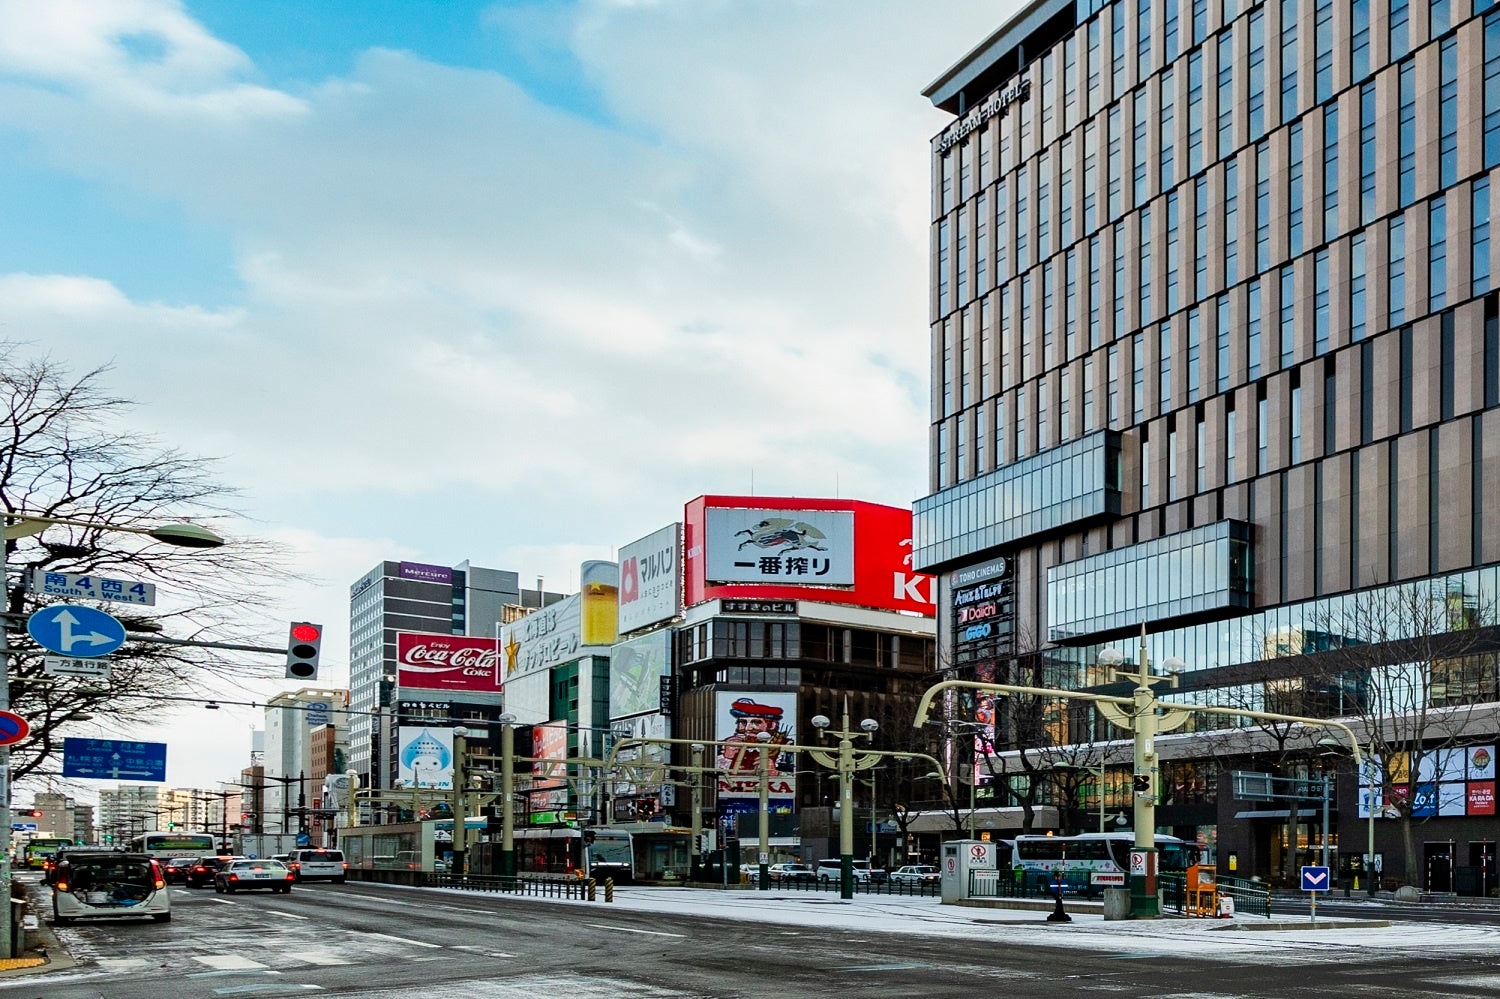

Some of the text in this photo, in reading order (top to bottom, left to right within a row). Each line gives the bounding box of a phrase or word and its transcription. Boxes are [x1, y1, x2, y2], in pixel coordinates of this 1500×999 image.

[640, 545, 673, 583] マルハン
[734, 556, 831, 576] 一番搾り
[960, 562, 1004, 583] TOHO CINEMAS
[404, 568, 449, 579] Mercure
[44, 585, 82, 596] South
[87, 590, 96, 598] 4
[102, 591, 133, 602] West
[724, 600, 794, 613] すすきのビル
[968, 602, 997, 620] Daiichi
[430, 641, 450, 650] Enjoy
[47, 660, 108, 669] 一方通行路
[405, 644, 498, 668] Coca-Cola
[463, 667, 493, 677] Coke
